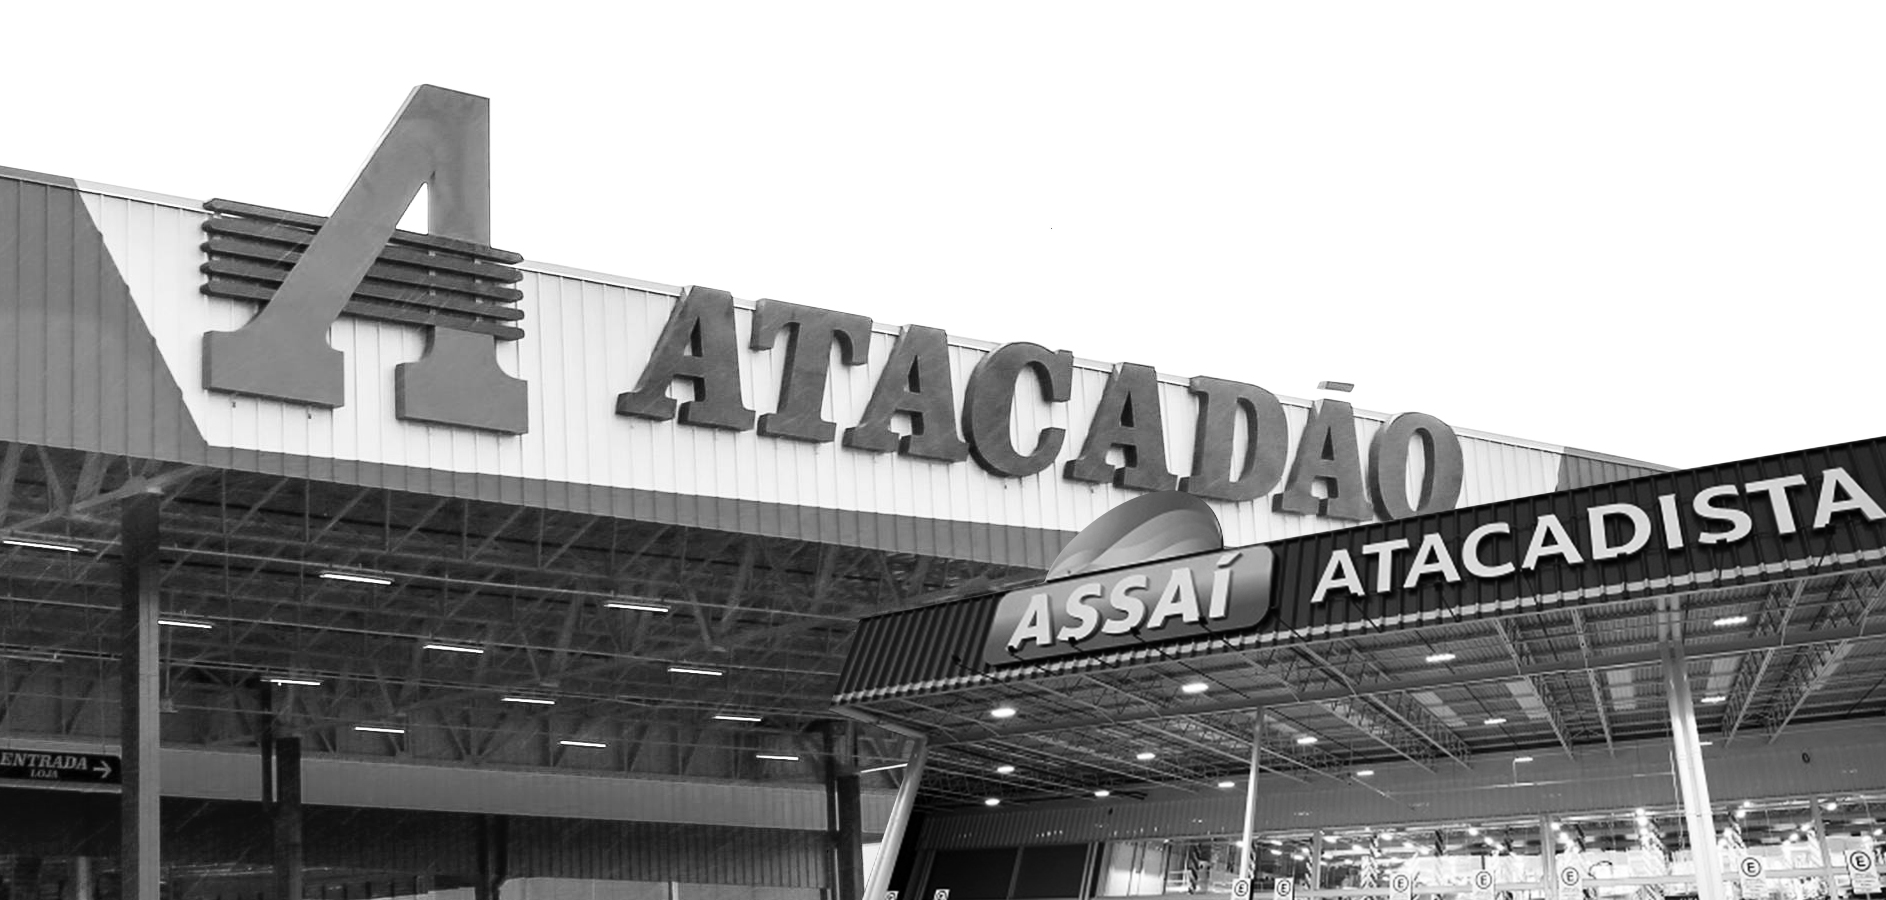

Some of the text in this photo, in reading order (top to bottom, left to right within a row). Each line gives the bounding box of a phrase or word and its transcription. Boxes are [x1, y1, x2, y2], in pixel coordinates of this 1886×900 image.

[615, 285, 1464, 521] ATACADÃO
[1005, 466, 1886, 653] ASSAÍ ATACADISTA
[0, 752, 88, 770] ENTRADA
[30, 769, 58, 779] LOJA
